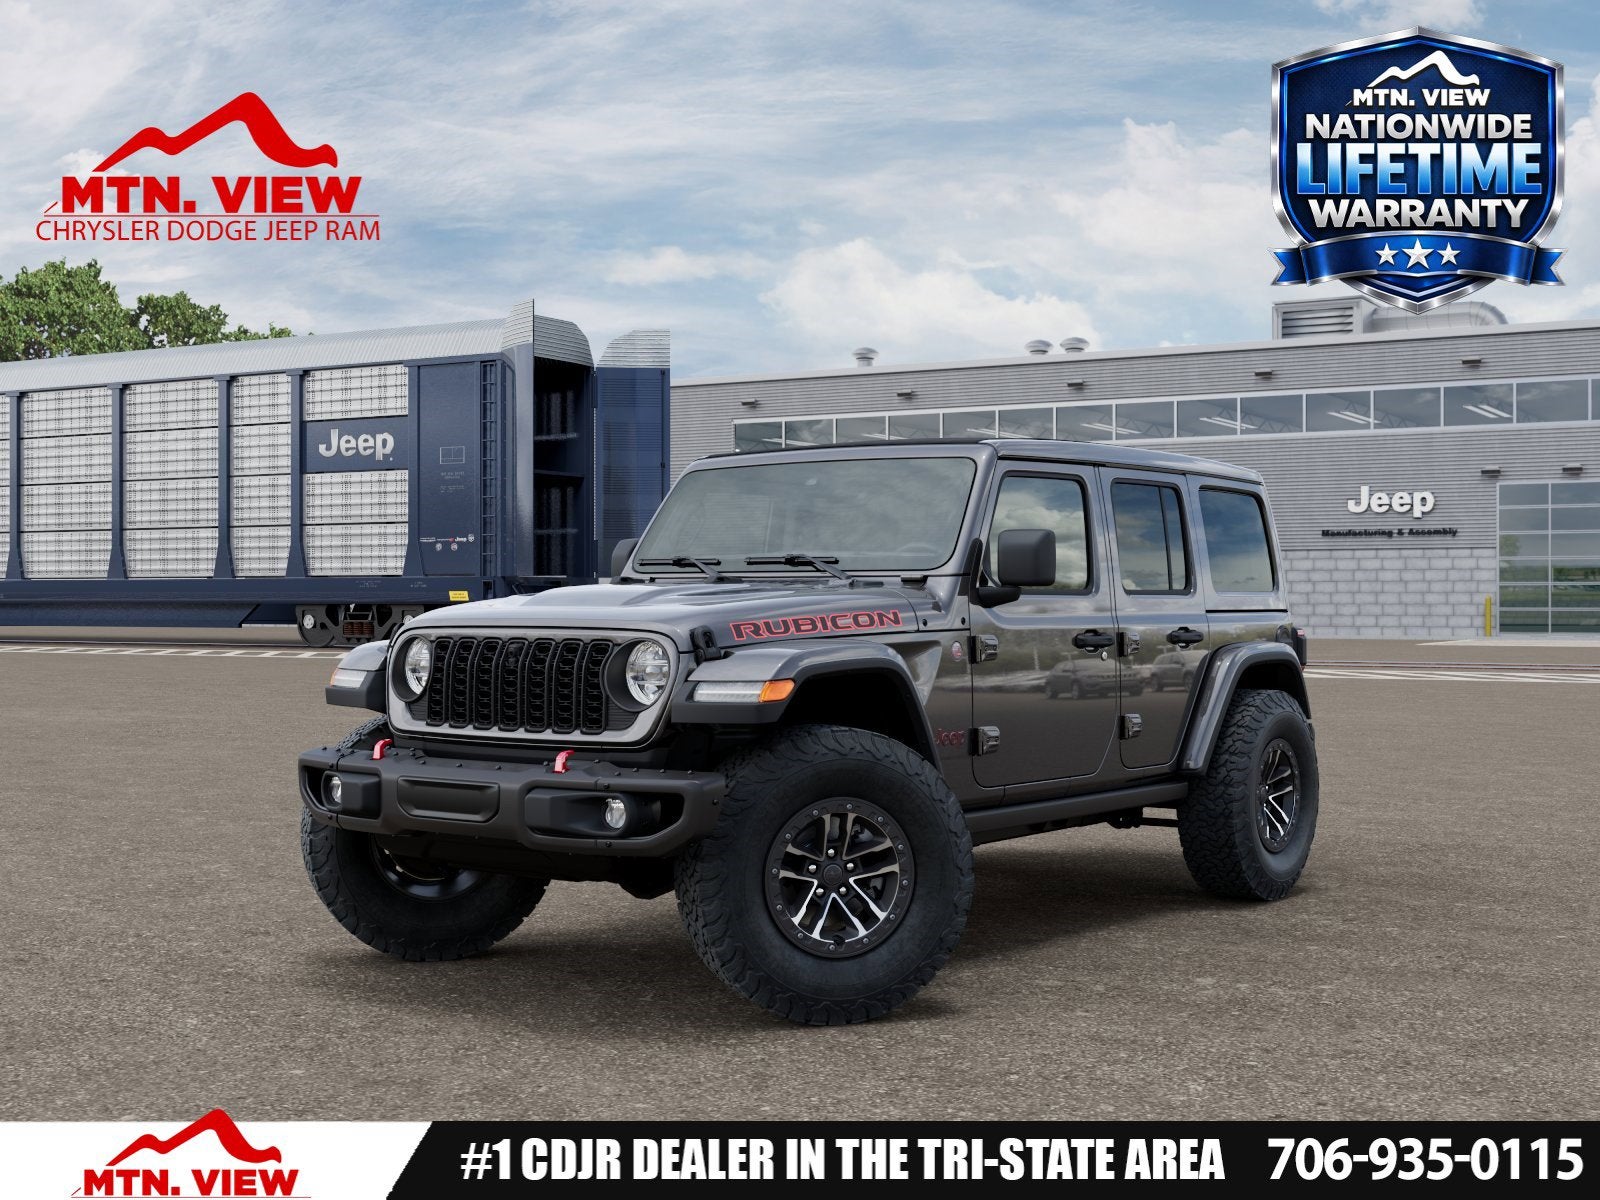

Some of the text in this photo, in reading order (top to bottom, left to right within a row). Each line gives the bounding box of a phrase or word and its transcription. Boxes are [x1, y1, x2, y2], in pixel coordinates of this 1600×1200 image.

[318, 428, 395, 461] Jeep
[1347, 485, 1435, 519] Jeep
[1321, 529, 1394, 538] Manufacturing
[1408, 527, 1458, 537] Assembly
[729, 609, 903, 641] RUBICON
